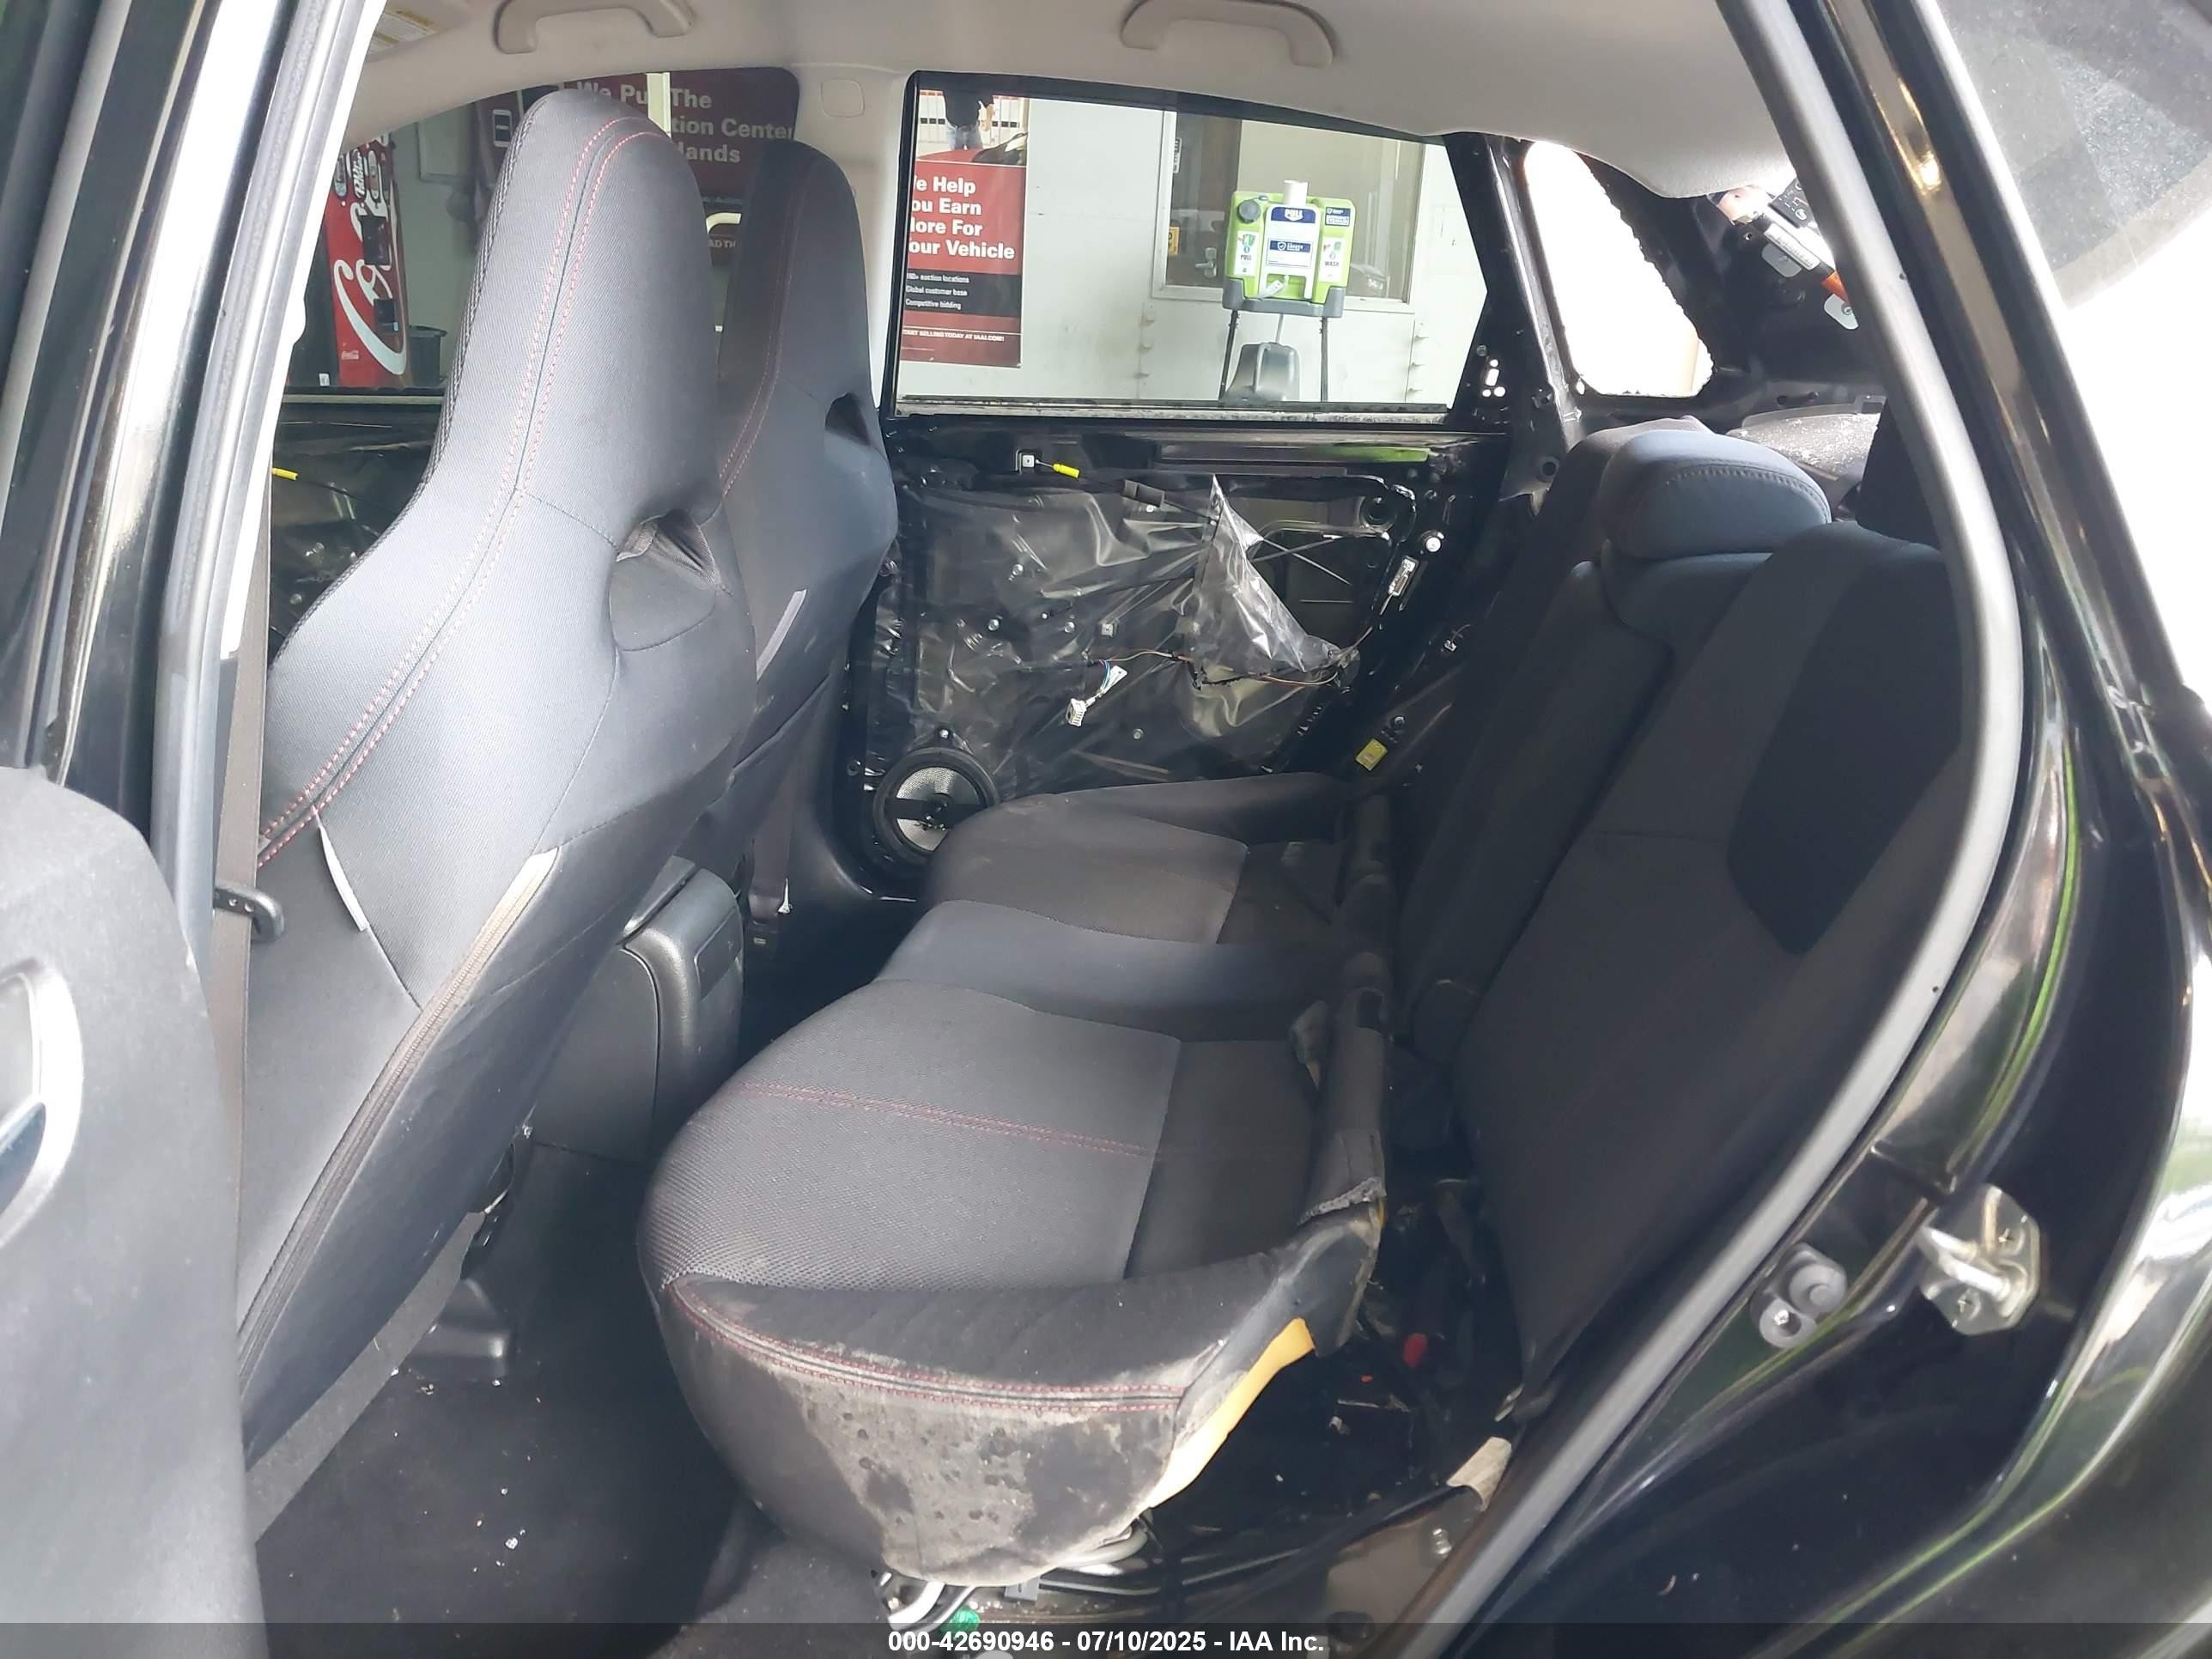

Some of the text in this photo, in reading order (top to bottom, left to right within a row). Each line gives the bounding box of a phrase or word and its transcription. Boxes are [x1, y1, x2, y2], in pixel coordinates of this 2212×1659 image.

[620, 84, 647, 105] Pu
[671, 88, 712, 108] The
[672, 115, 714, 136] tion
[914, 174, 976, 198] e Help
[911, 198, 982, 216] ou Earn
[951, 219, 983, 236] For
[908, 237, 1016, 259] our Vehicle
